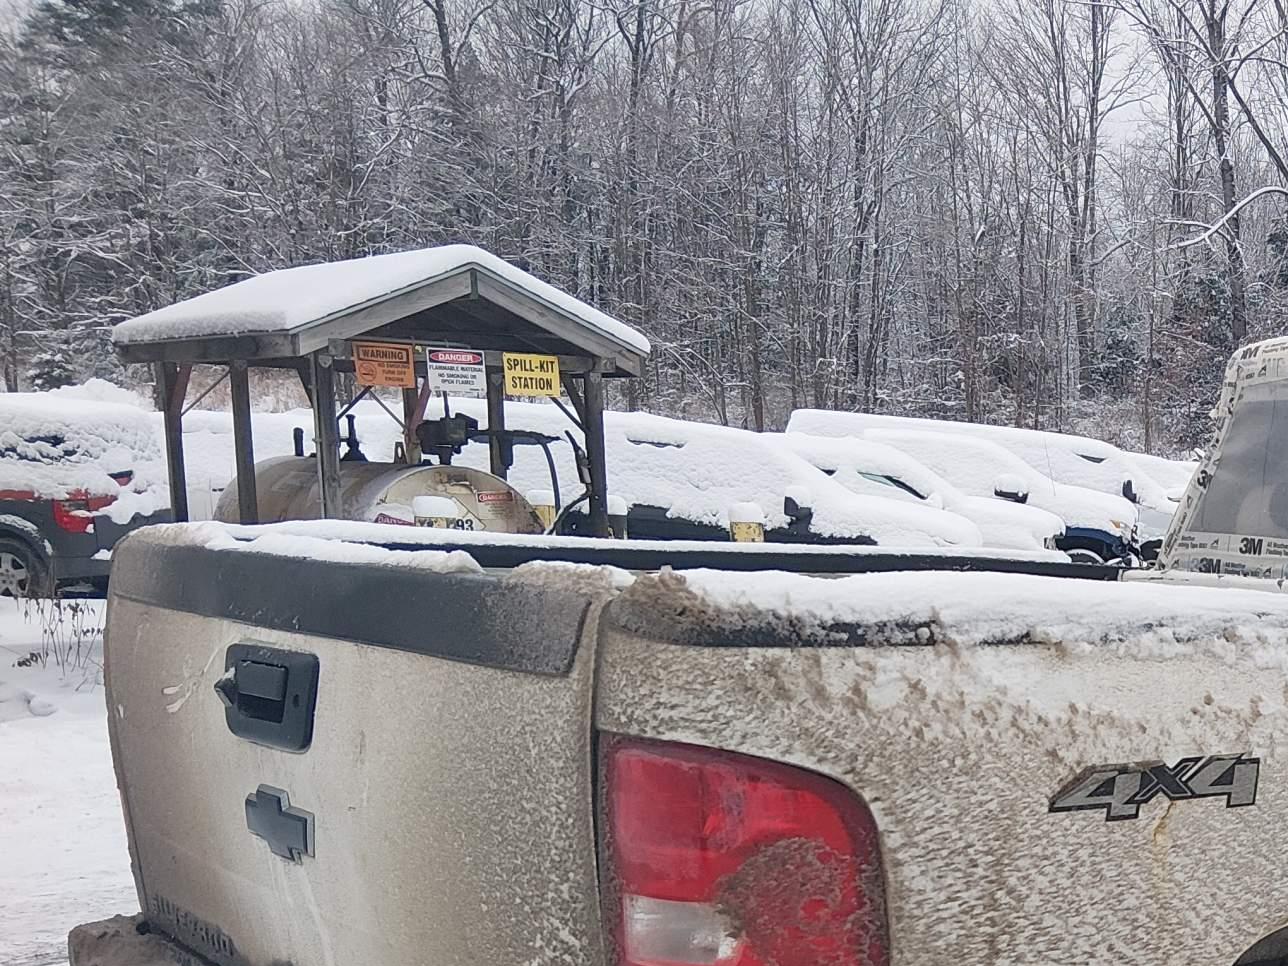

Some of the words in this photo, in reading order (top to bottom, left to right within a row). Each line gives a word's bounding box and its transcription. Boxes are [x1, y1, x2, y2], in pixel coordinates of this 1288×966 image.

[361, 349, 404, 360] WARNING
[438, 353, 472, 362] DANGER
[506, 358, 555, 373] SPILL-KIT
[511, 375, 553, 390] STATION
[1239, 537, 1263, 555] 3M
[1199, 557, 1221, 574] 3M
